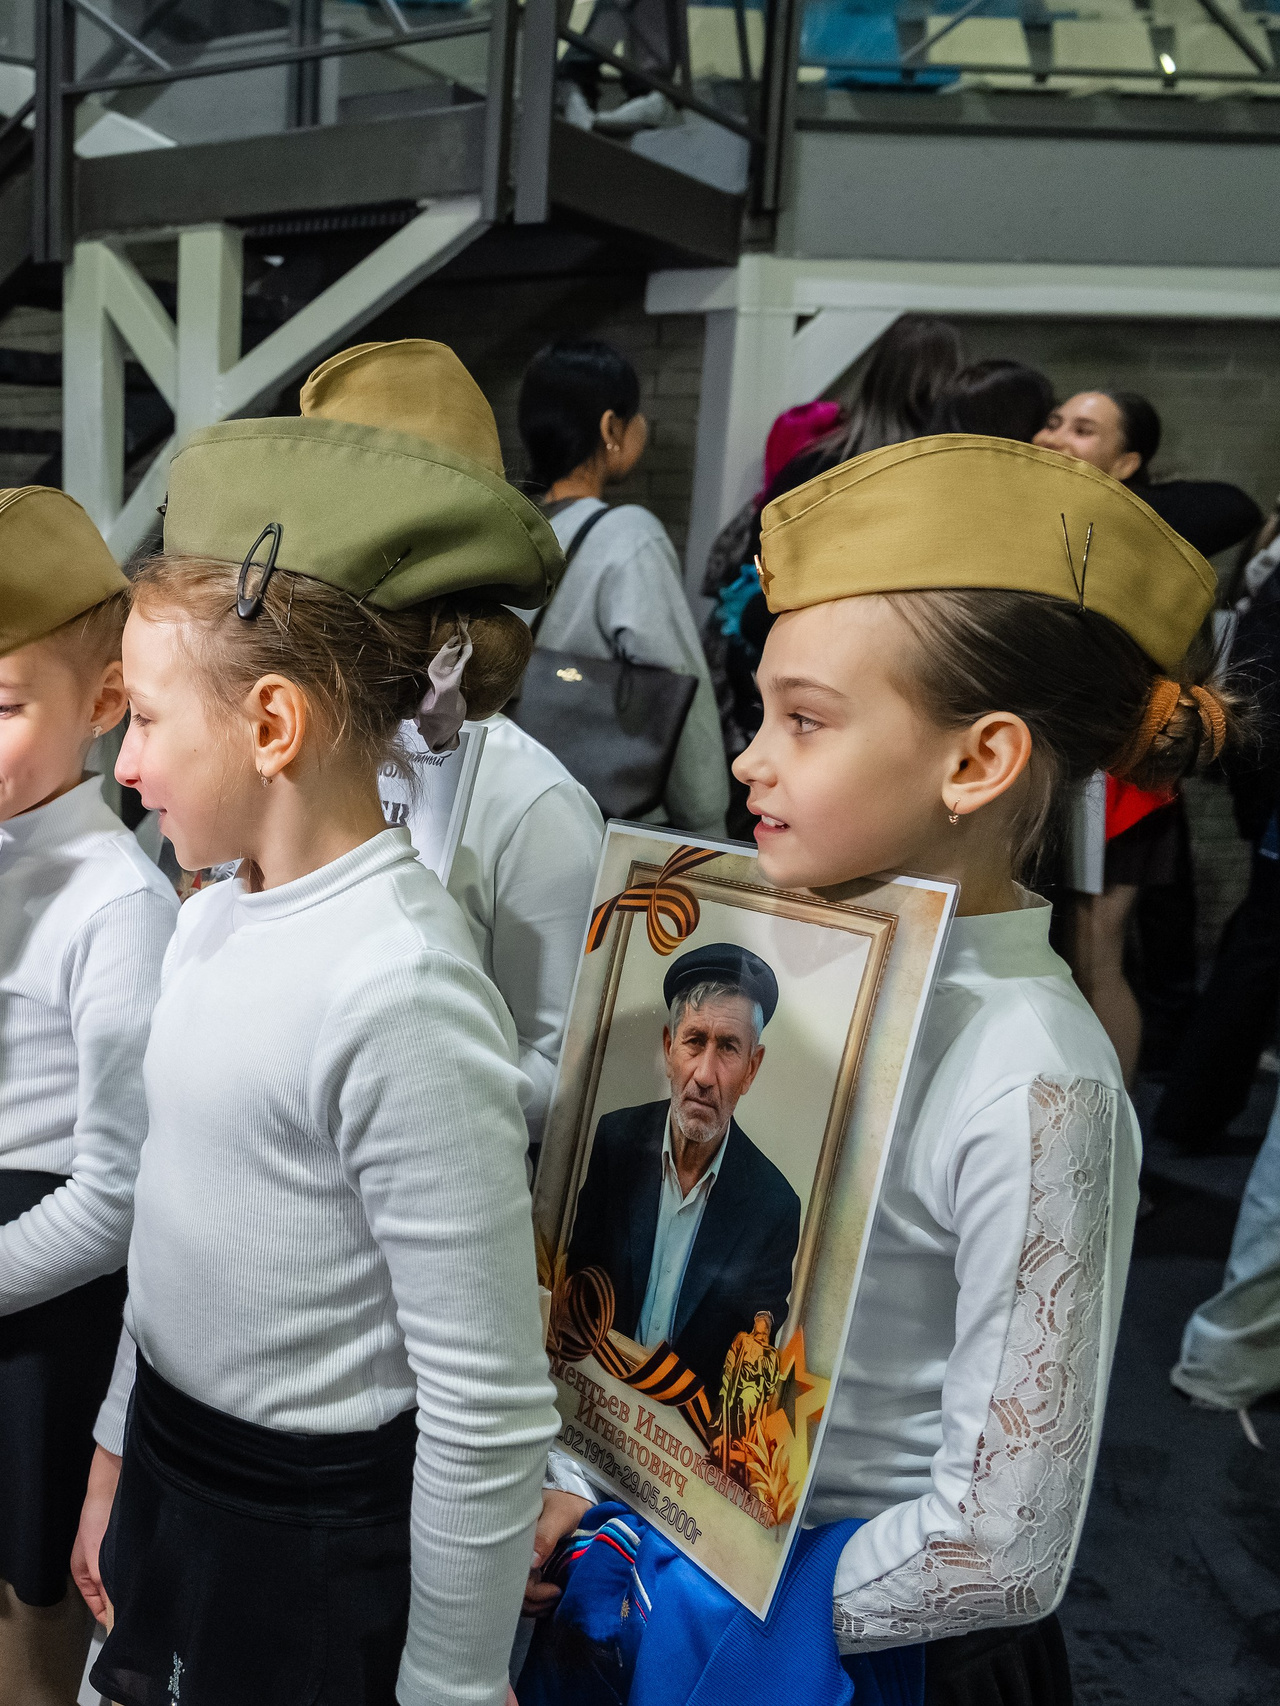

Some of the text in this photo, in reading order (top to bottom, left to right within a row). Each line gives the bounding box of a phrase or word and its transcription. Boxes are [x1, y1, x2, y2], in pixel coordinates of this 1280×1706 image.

[549, 1354, 775, 1530] ментьев Иннокентий
[555, 1424, 703, 1546] .02.1912г-29.05.2000г
[574, 1394, 688, 1498] Игнатович
